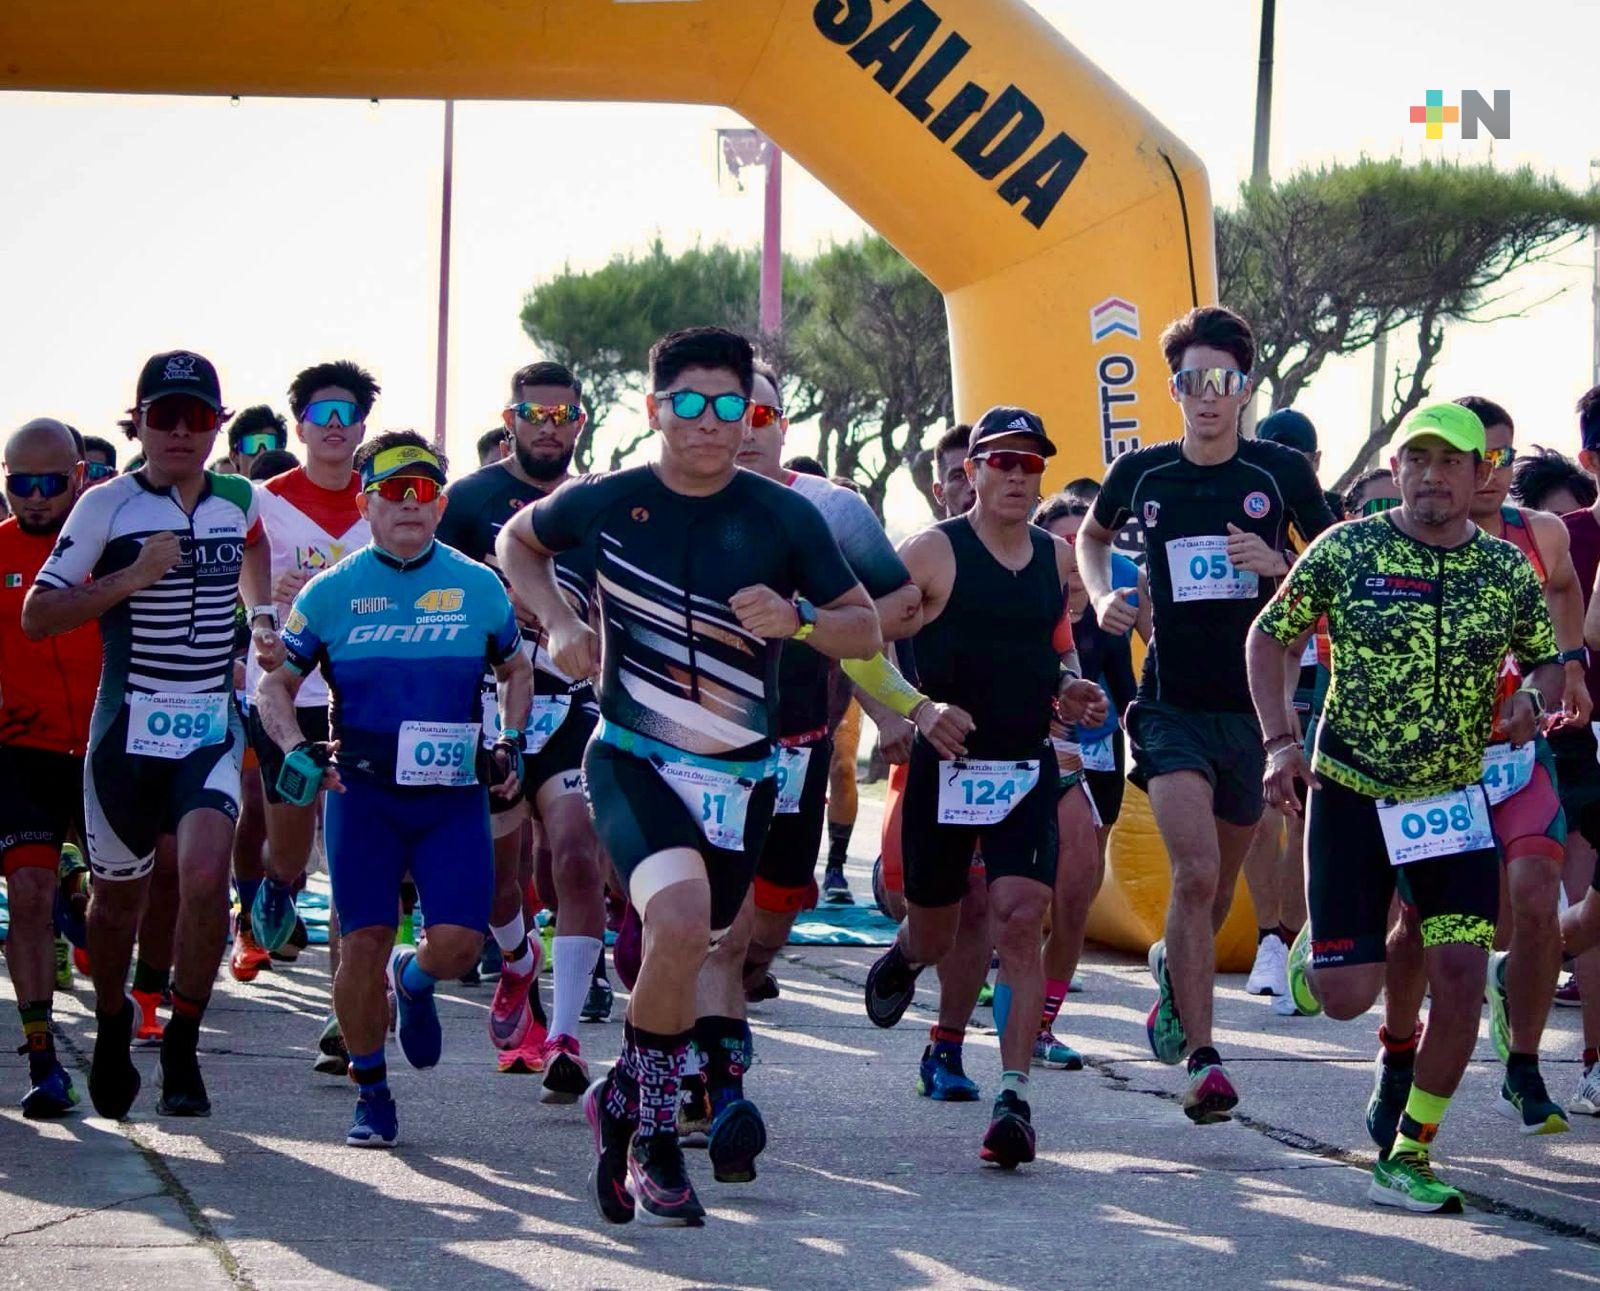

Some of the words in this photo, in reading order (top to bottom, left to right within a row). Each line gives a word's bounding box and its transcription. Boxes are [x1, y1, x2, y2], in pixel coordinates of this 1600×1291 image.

[414, 588, 465, 613] 46
[416, 614, 467, 624] DIEGOGOO!
[346, 624, 470, 645] GIANT
[147, 711, 211, 739] 089
[414, 741, 466, 767] 039
[961, 779, 1015, 805] 124
[1401, 804, 1471, 839] 098
